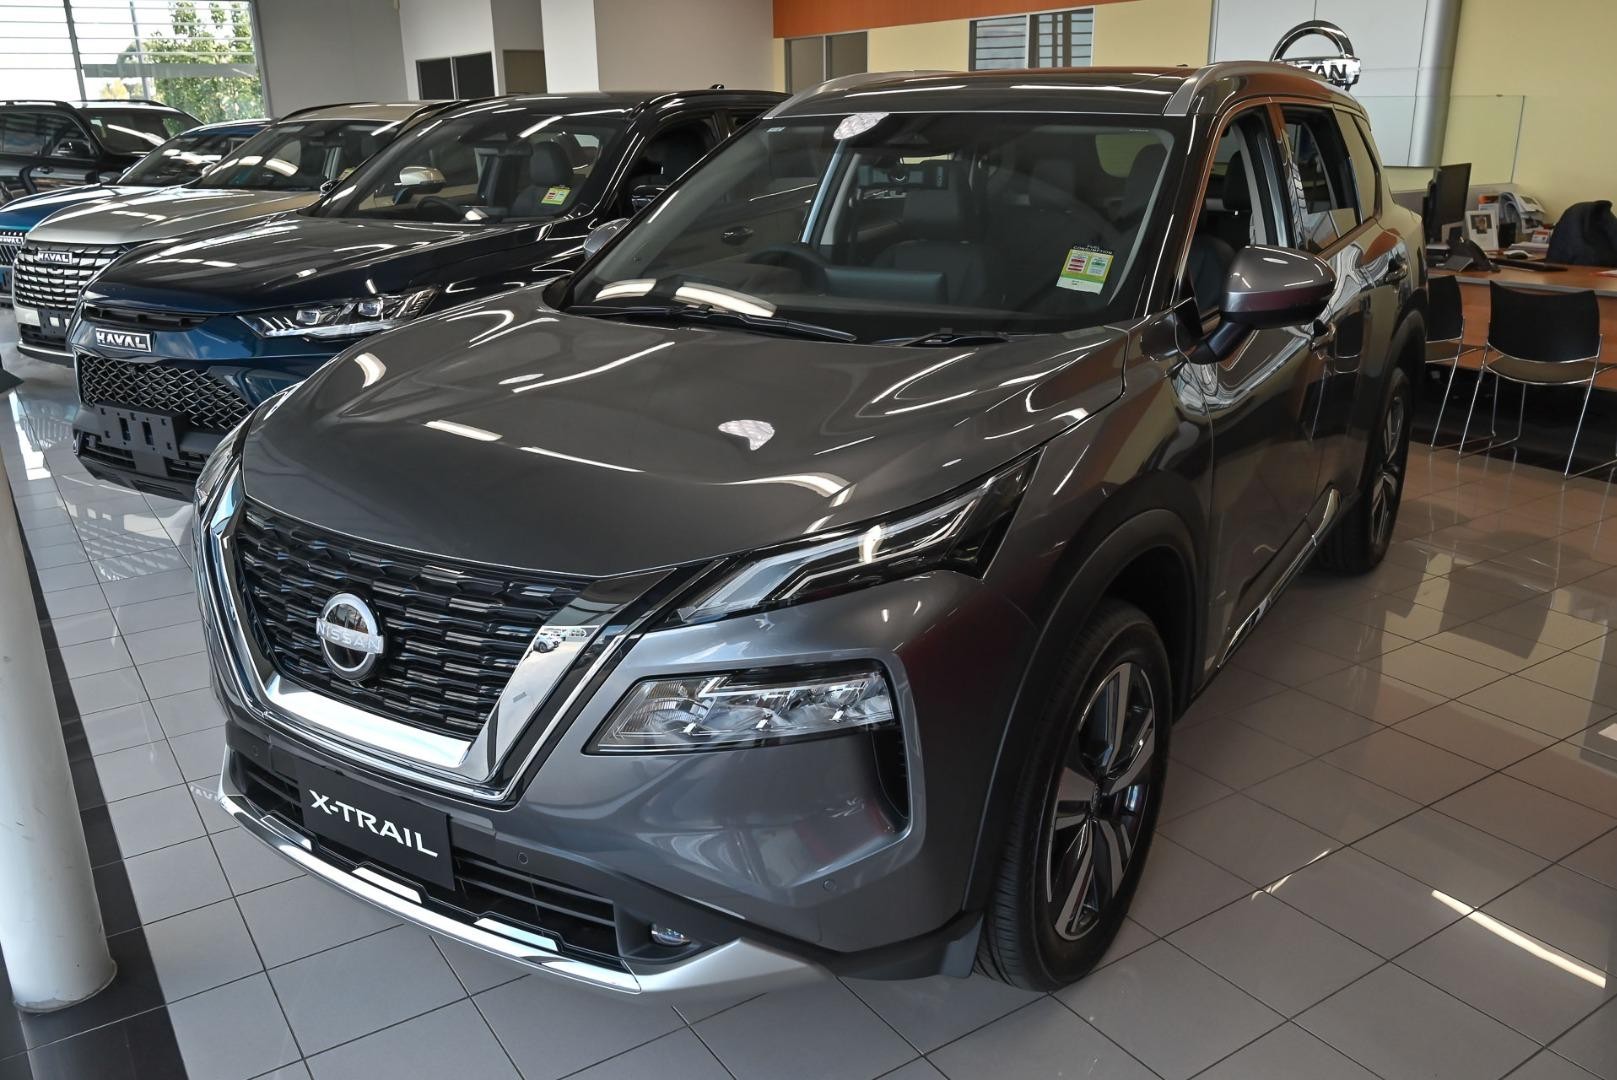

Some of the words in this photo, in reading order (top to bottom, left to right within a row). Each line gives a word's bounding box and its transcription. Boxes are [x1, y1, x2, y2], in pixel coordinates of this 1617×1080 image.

[1300, 64, 1346, 80] AN
[96, 331, 147, 349] HAVAL
[316, 619, 381, 650] NISSAN
[309, 789, 439, 858] X-TRAIL
